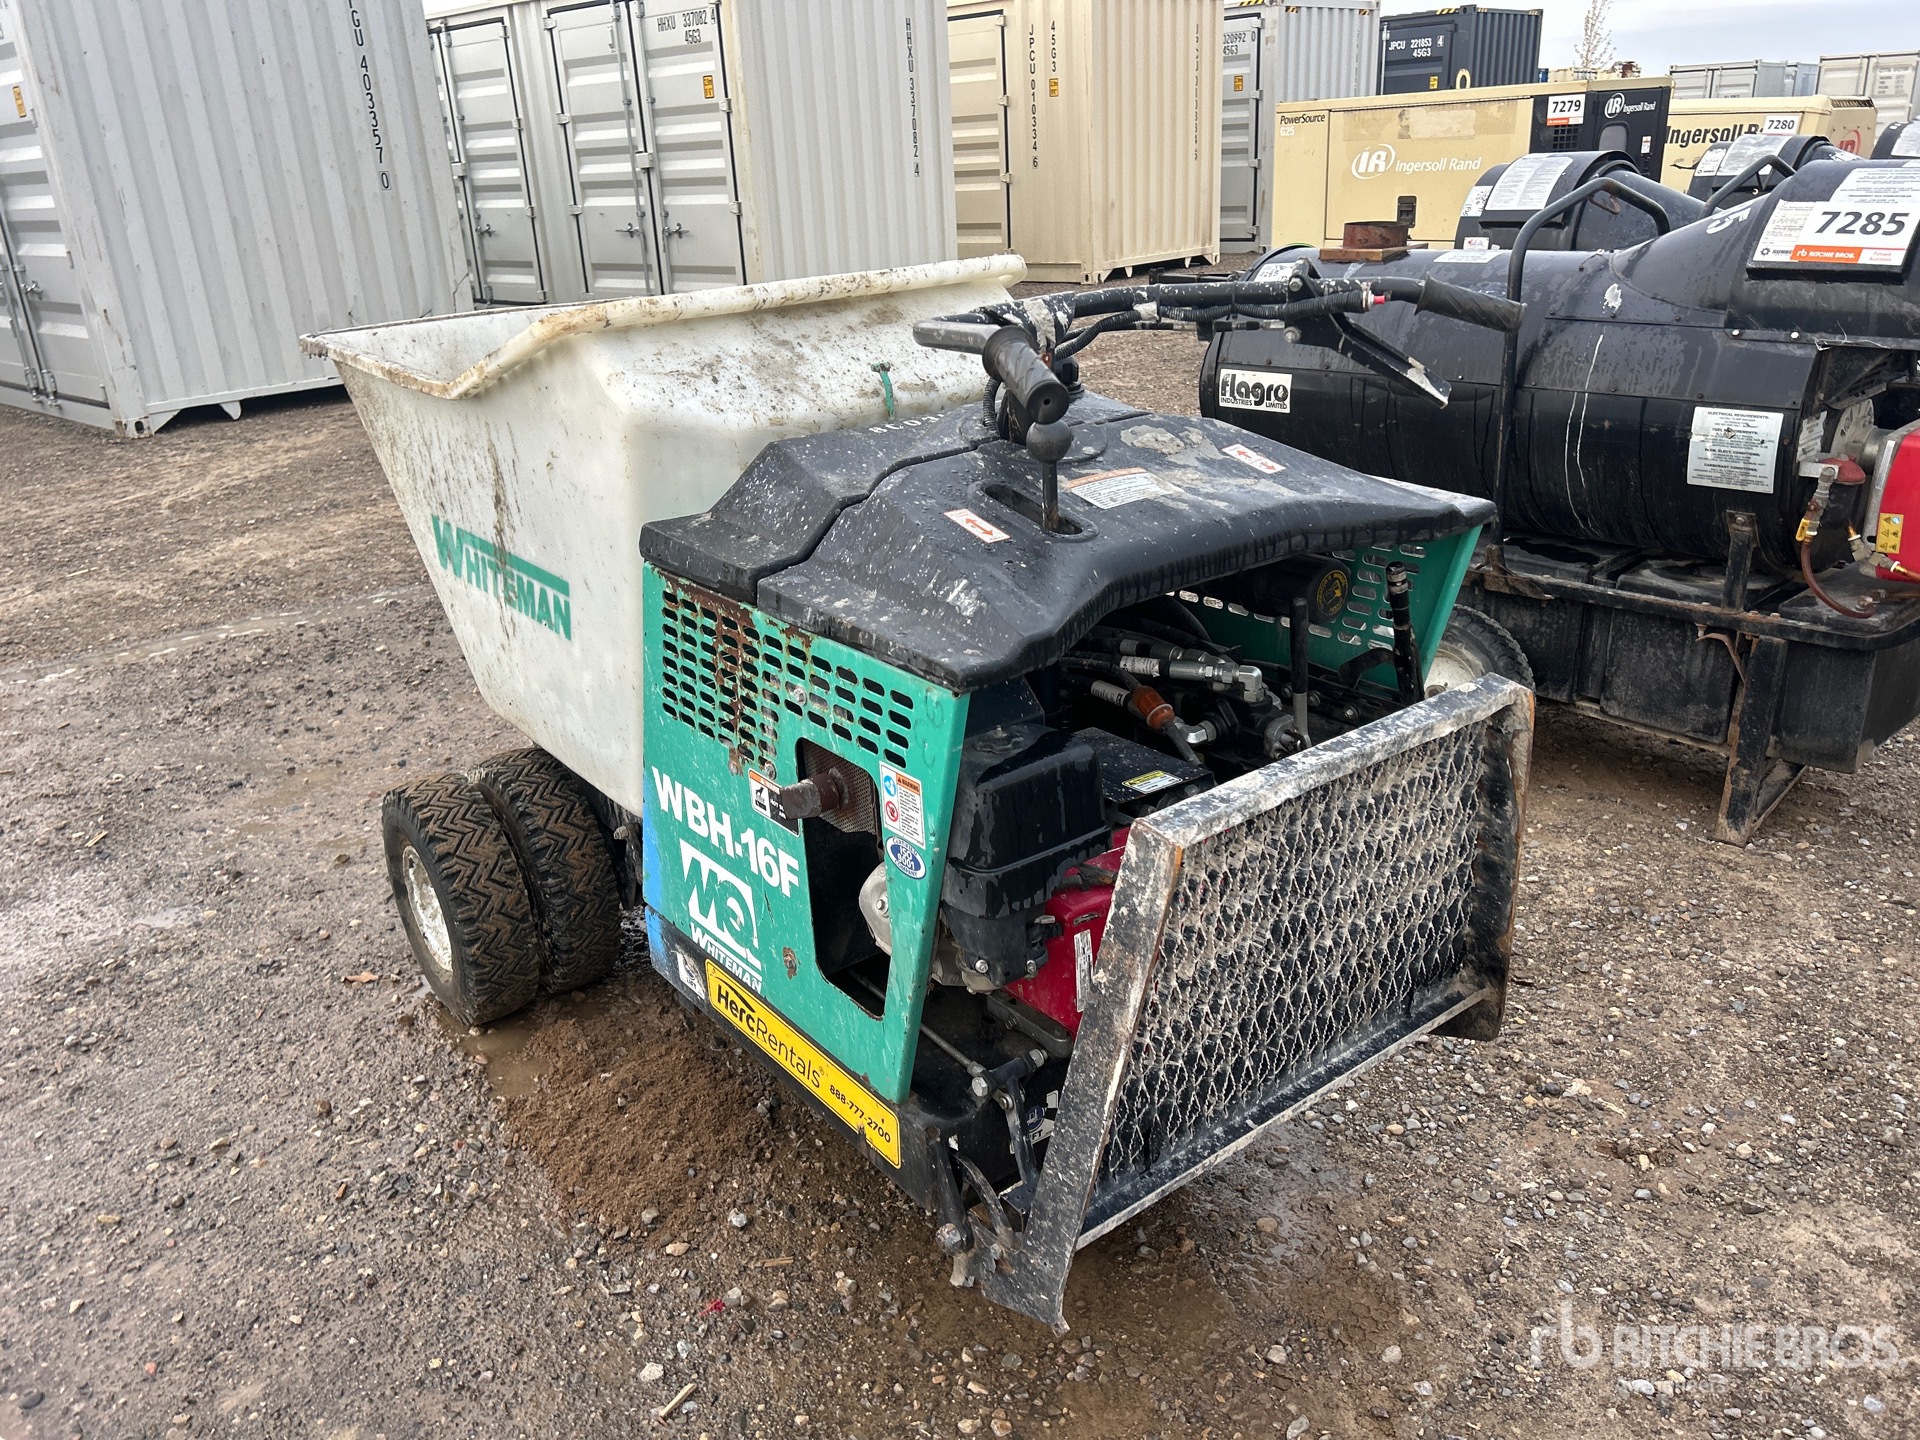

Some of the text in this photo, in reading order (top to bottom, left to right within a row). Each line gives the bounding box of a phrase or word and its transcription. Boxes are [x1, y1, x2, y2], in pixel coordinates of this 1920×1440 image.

[682, 10, 708, 28] 337082
[1389, 41, 1406, 51] JPCU
[1410, 38, 1432, 48] 221853
[1412, 48, 1431, 57] 45G3
[349, 0, 364, 47] GU
[360, 54, 384, 164] 403357
[1030, 79, 1038, 152] 010334
[1552, 100, 1581, 113] 7279
[910, 77, 919, 157] 337082
[1280, 114, 1325, 125] PowerSource
[1767, 119, 1795, 130] 7280
[1666, 124, 1742, 148] Ingersoll
[1395, 159, 1448, 174] Ingersoll
[1449, 157, 1482, 171] Rand
[1815, 212, 1910, 236] 7285
[1221, 374, 1288, 406] flagro
[1221, 397, 1287, 410] INDUSTRIES LIMITED
[431, 514, 571, 641] WHITEMAN
[897, 853, 915, 871] 9001
[899, 846, 912, 860] ISO
[690, 922, 762, 994] WHITEMAN
[829, 1084, 891, 1143] 888-777-2700
